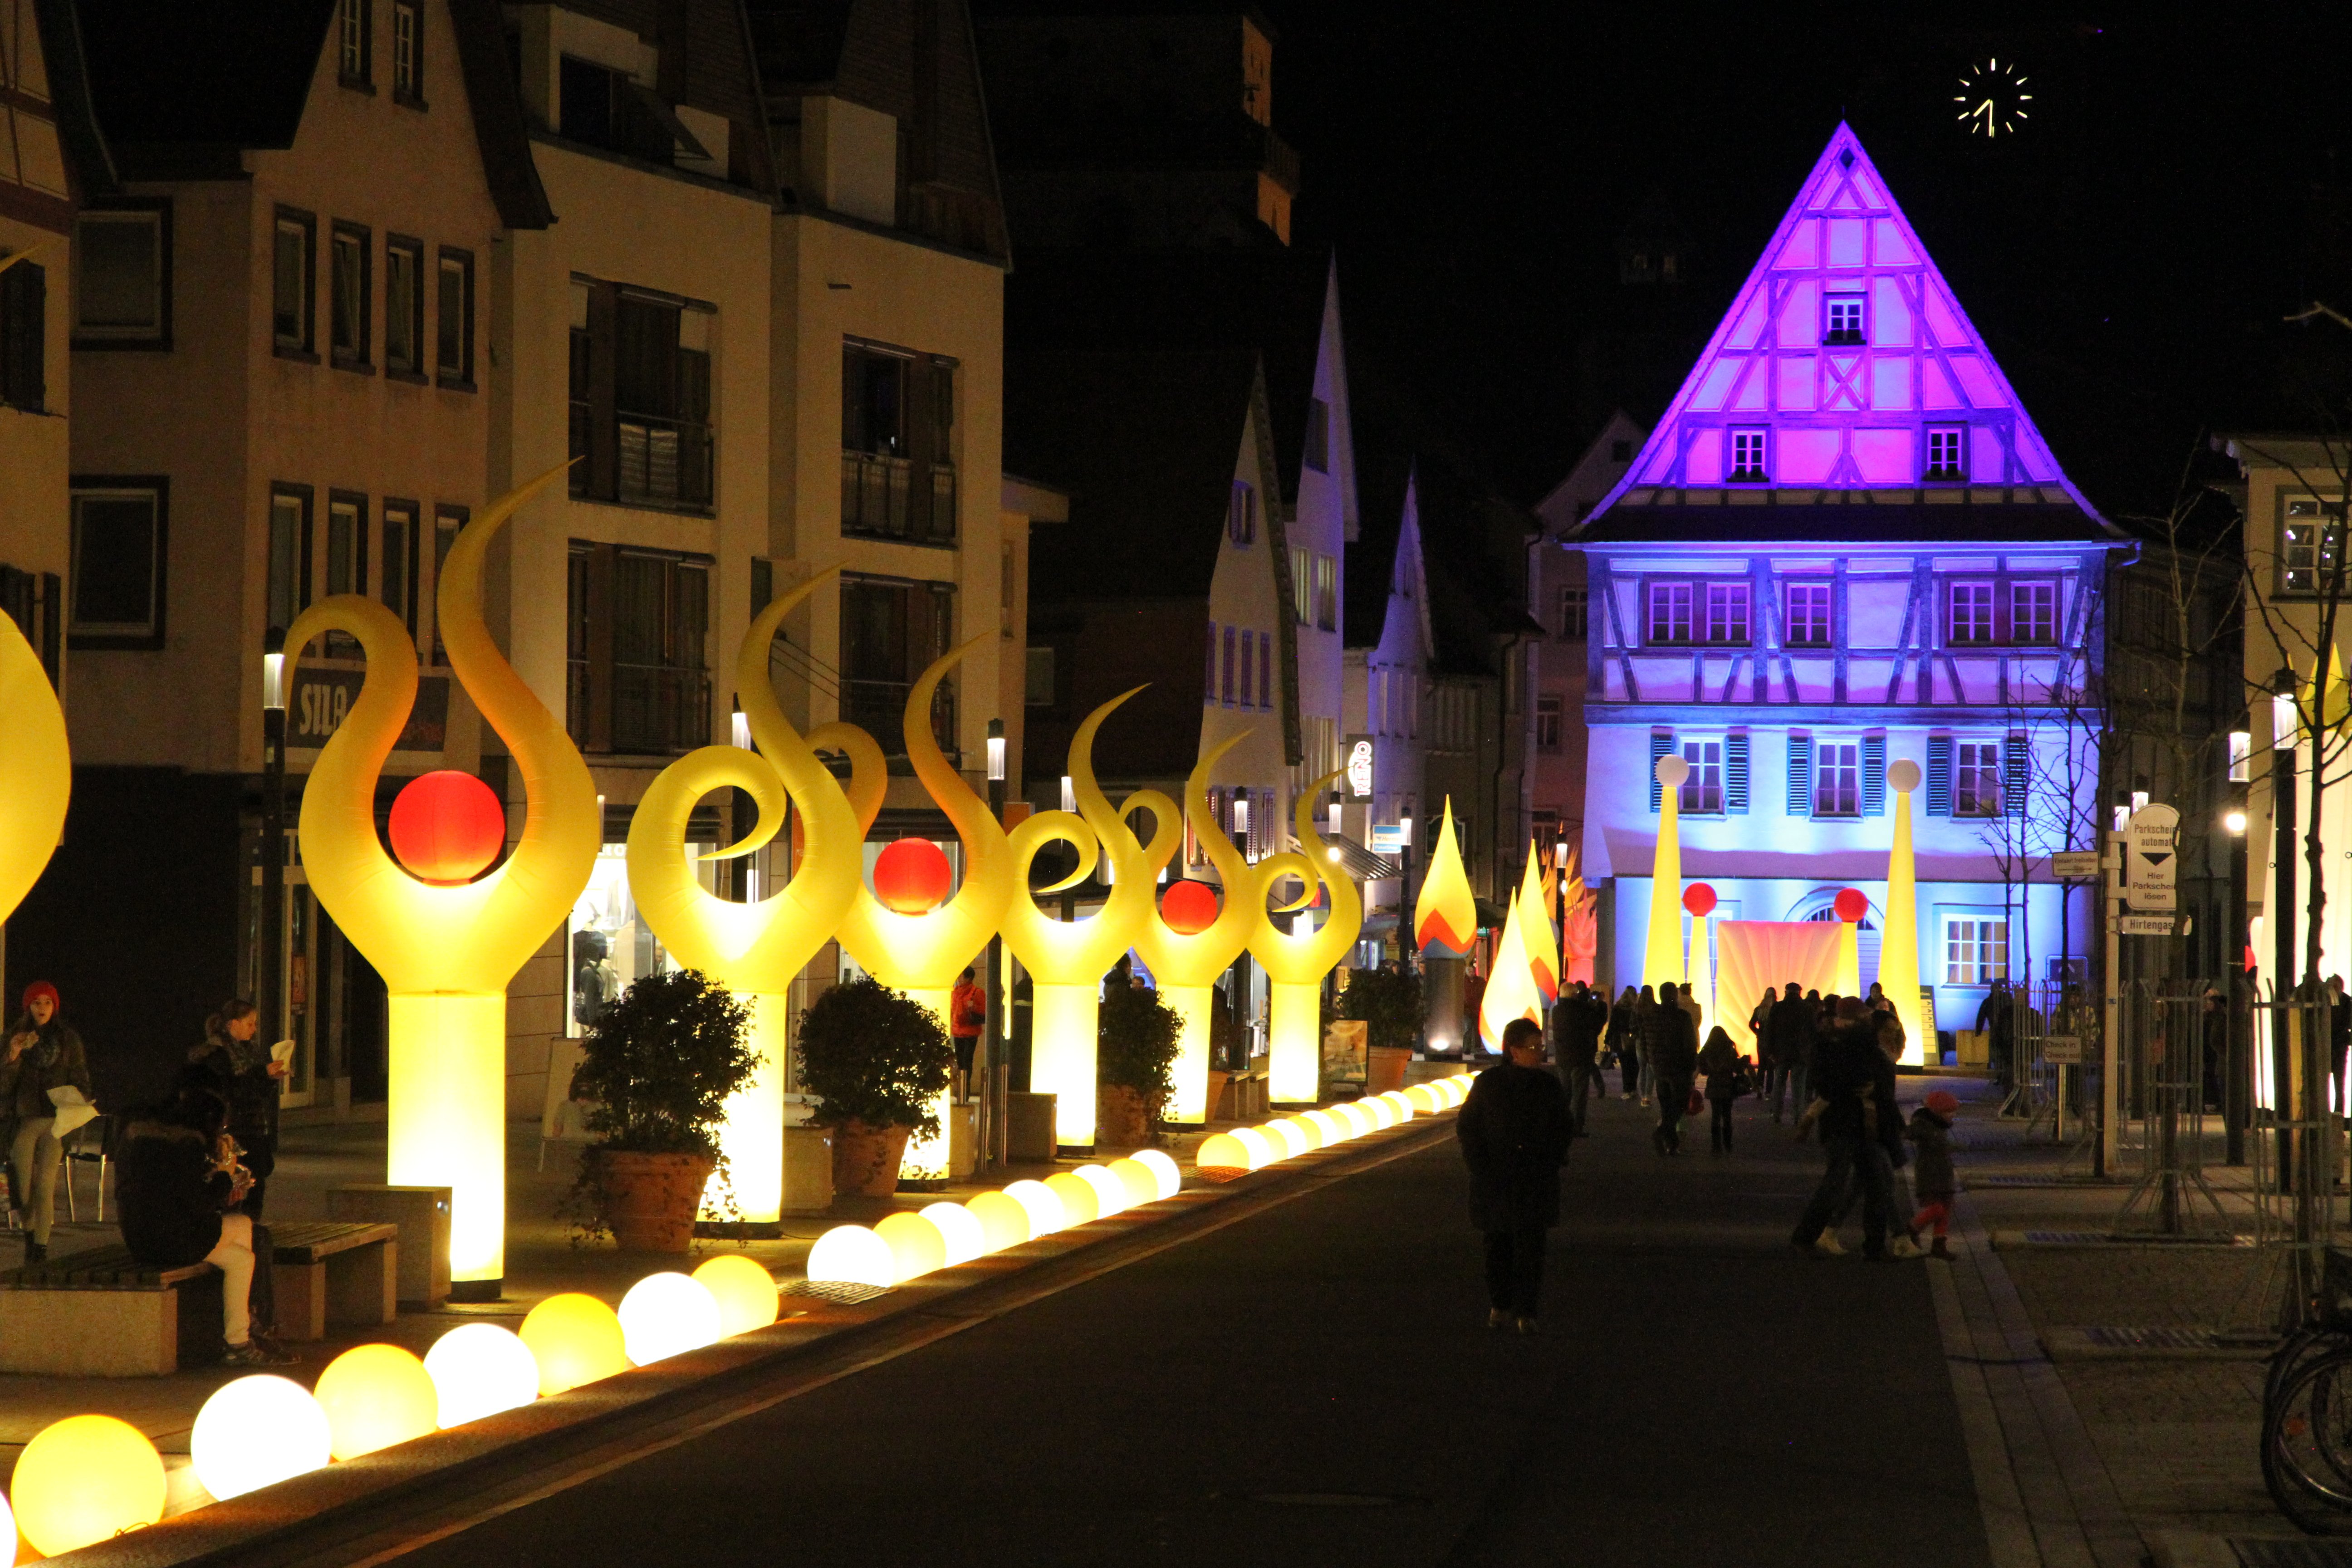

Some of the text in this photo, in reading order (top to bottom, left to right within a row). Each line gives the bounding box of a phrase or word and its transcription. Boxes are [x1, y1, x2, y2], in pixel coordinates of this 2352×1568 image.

[1355, 741, 1371, 796] RENO
[2141, 837, 2172, 846] automat
[2130, 919, 2172, 932] Hirtengas
